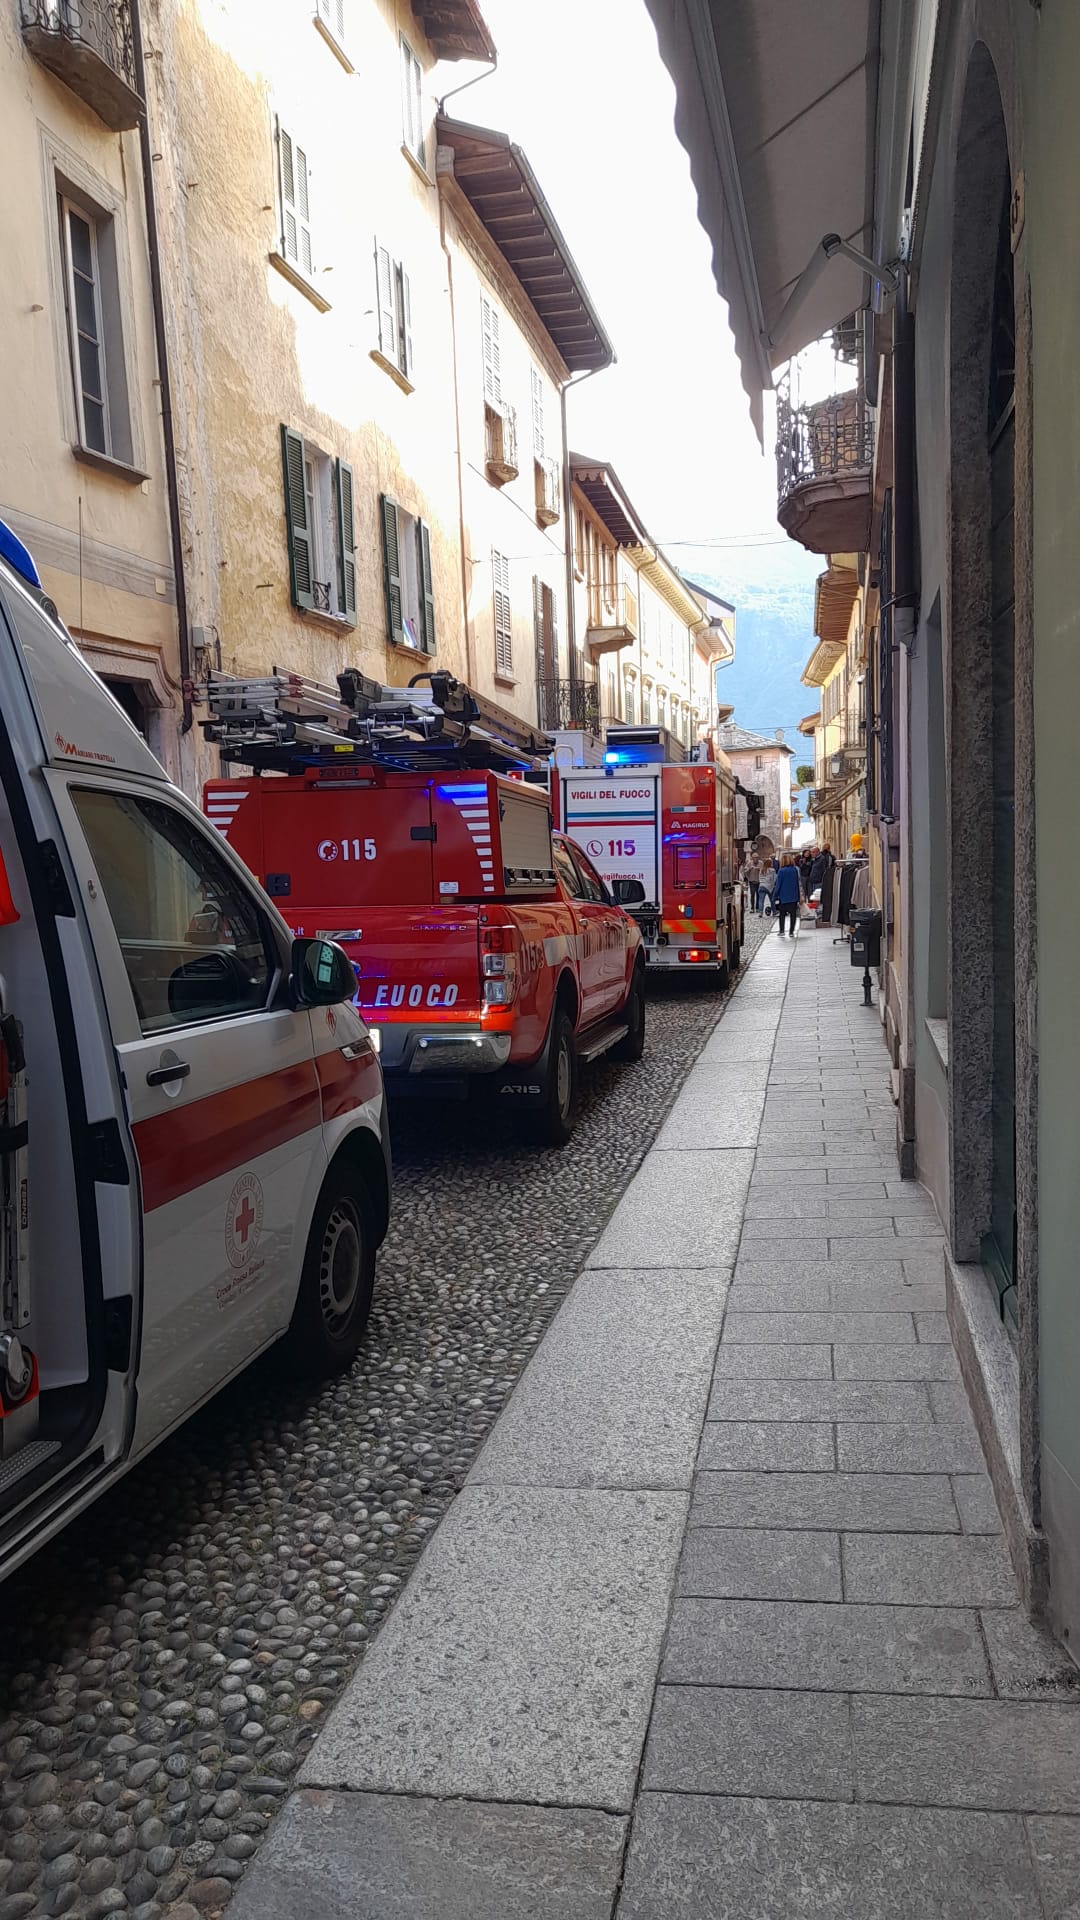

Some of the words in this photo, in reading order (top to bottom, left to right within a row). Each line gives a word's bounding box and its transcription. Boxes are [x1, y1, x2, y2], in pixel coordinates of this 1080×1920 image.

[571, 791, 597, 800] VIGILI
[599, 791, 617, 799] DEL
[619, 789, 651, 799] FUOCO
[341, 838, 377, 861] 115
[608, 839, 636, 857] 115
[600, 872, 645, 881] vigilfuoco.it
[375, 984, 459, 1007] FUOCO
[500, 1085, 541, 1094] ARIS
